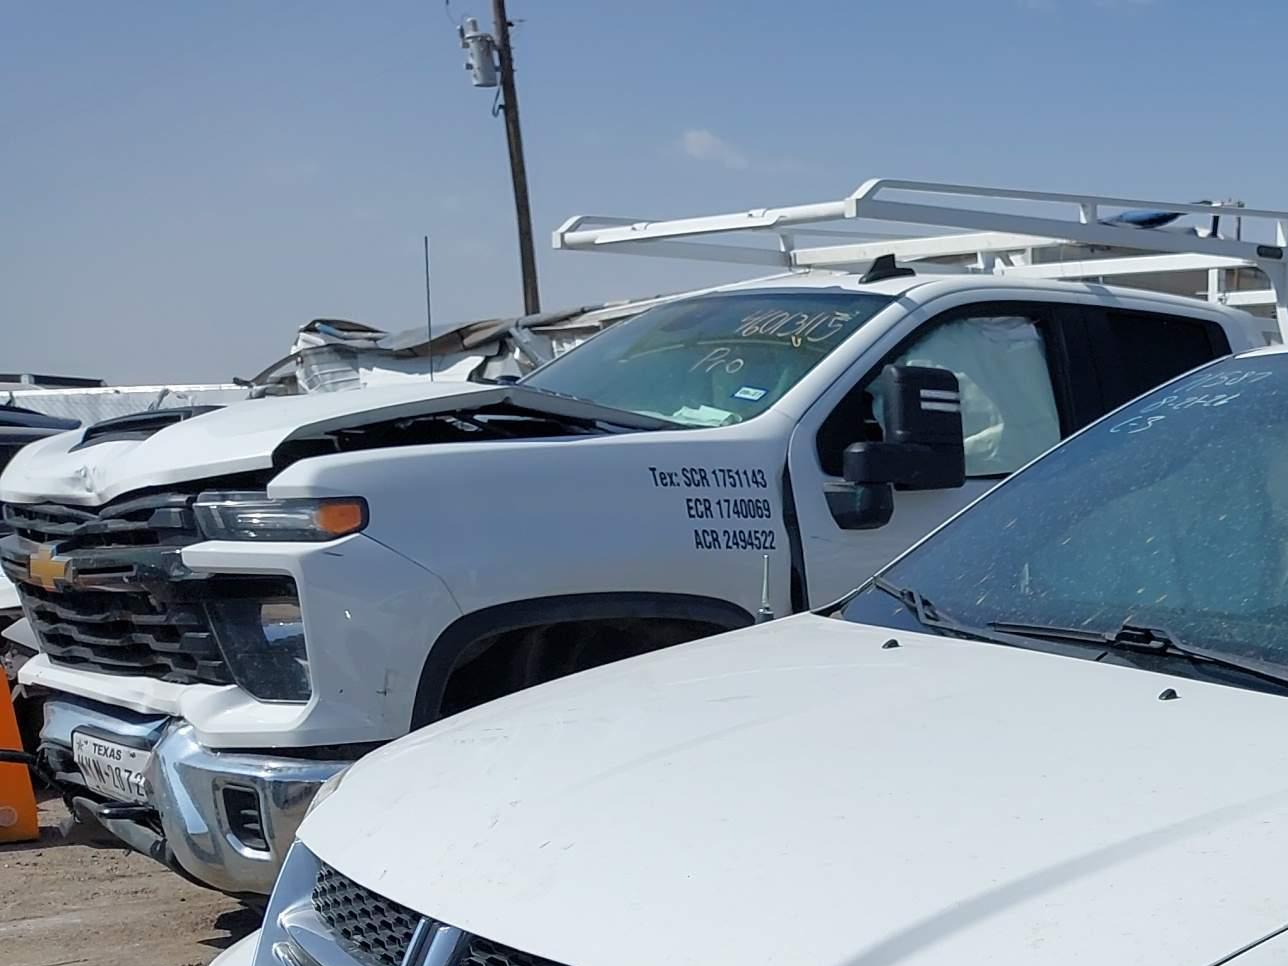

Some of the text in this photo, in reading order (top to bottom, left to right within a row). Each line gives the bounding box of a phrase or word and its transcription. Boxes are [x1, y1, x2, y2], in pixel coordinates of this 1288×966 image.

[688, 347, 745, 374] Pro
[648, 467, 768, 489] Tex: SCR 1751143
[685, 498, 772, 519] ECR 1740069
[694, 529, 777, 550] ACR 2494522
[92, 743, 122, 761] TEXAS
